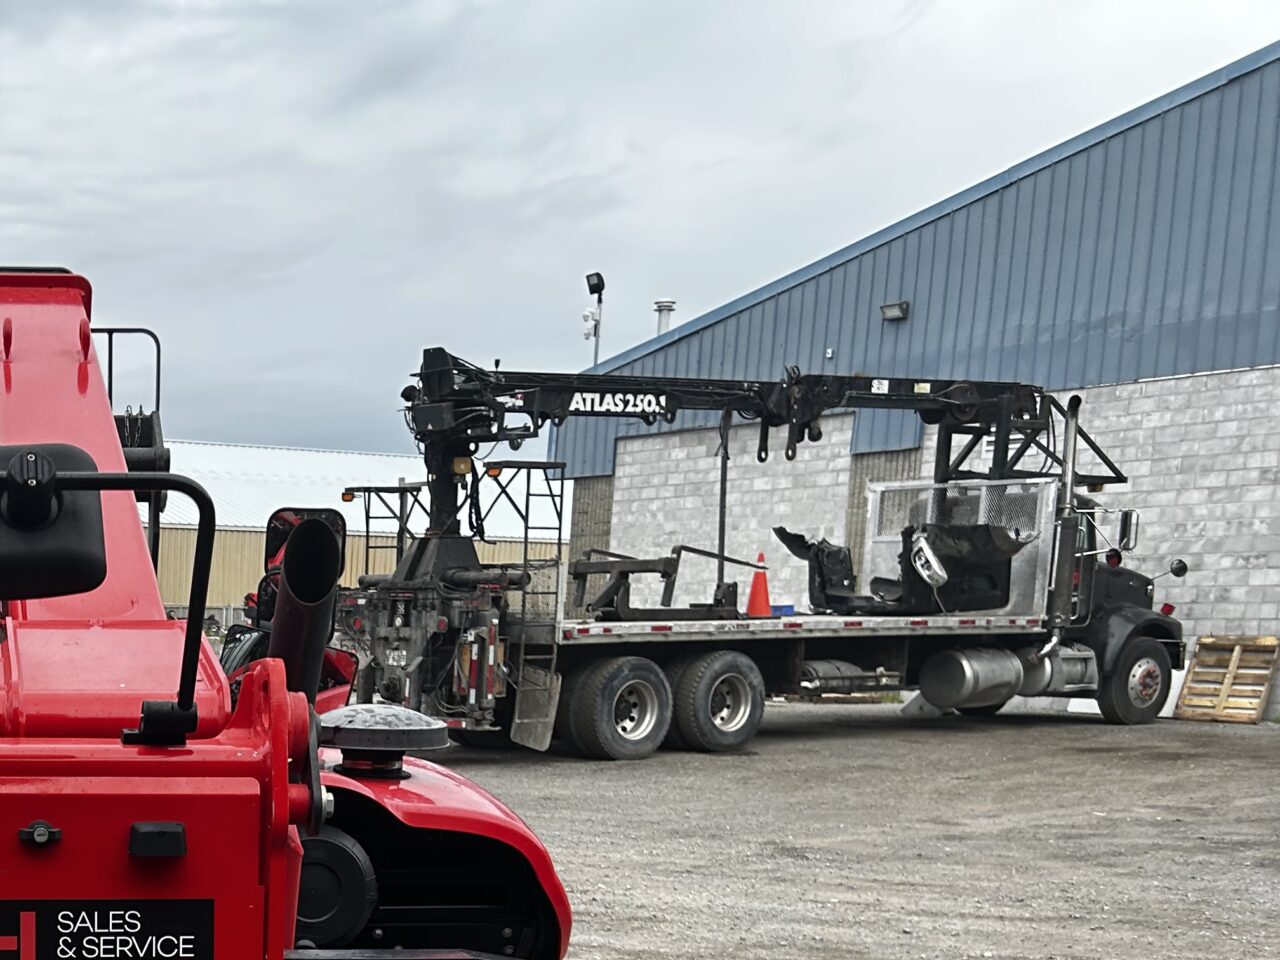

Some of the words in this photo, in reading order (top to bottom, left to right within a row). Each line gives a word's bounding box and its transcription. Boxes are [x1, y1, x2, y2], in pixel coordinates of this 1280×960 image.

[57, 911, 141, 933] SALES
[57, 936, 76, 958] &
[83, 936, 195, 958] SERVICE
